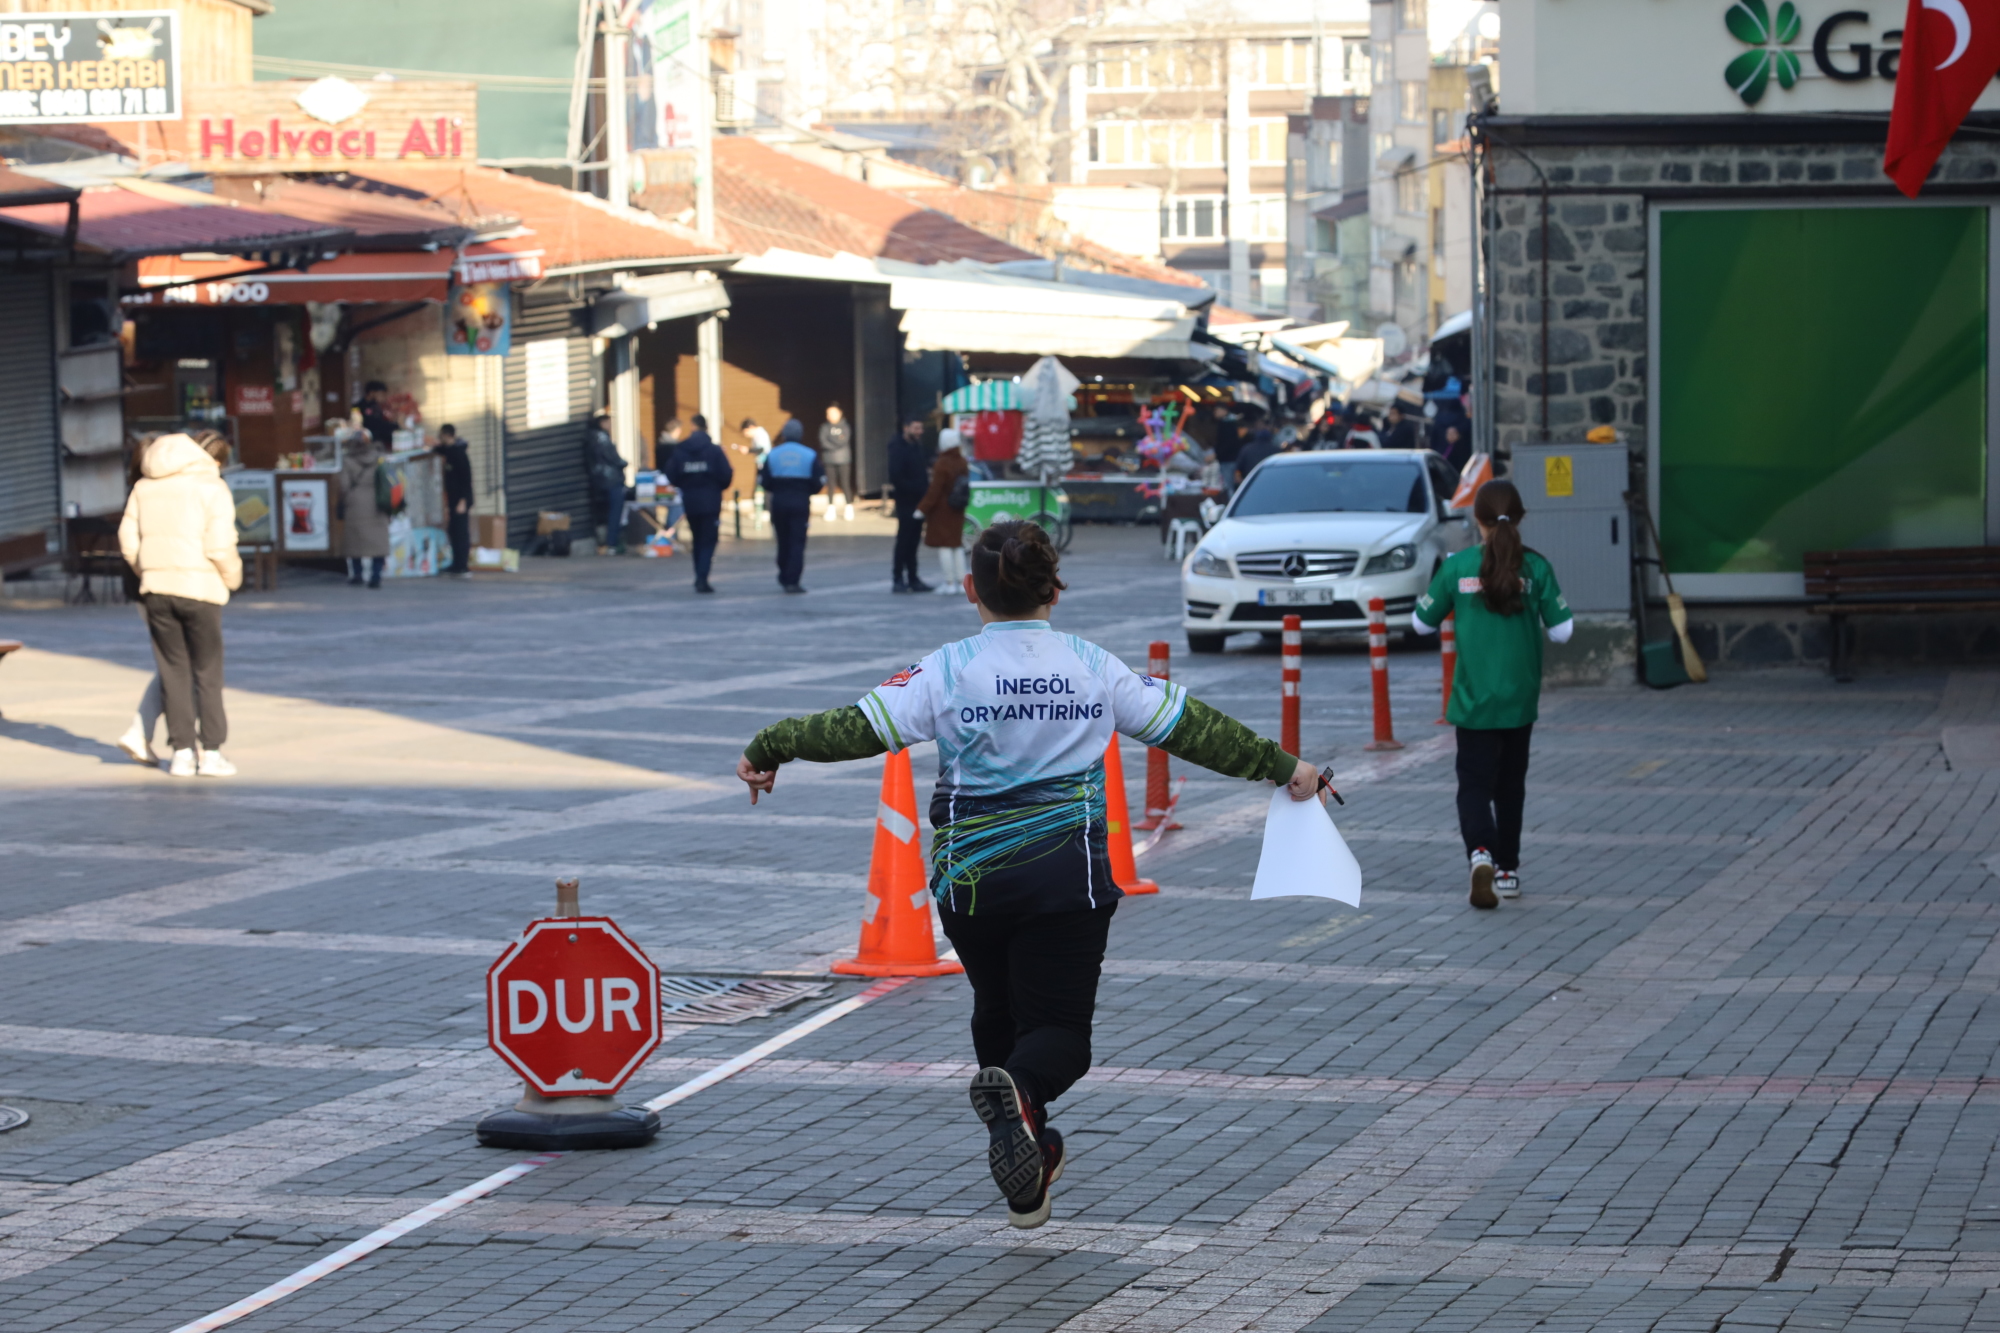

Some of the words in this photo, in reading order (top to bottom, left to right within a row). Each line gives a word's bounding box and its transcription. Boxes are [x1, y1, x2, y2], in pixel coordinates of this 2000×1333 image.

[1813, 10, 1905, 81] Ga
[58, 59, 166, 90] KEBABI
[201, 118, 376, 158] Helvacı
[398, 117, 463, 157] Ali
[206, 283, 270, 303] 1900
[996, 673, 1075, 695] İNEGÖL
[960, 699, 1103, 723] ORYANTİRİNG
[508, 977, 642, 1035] DUR
